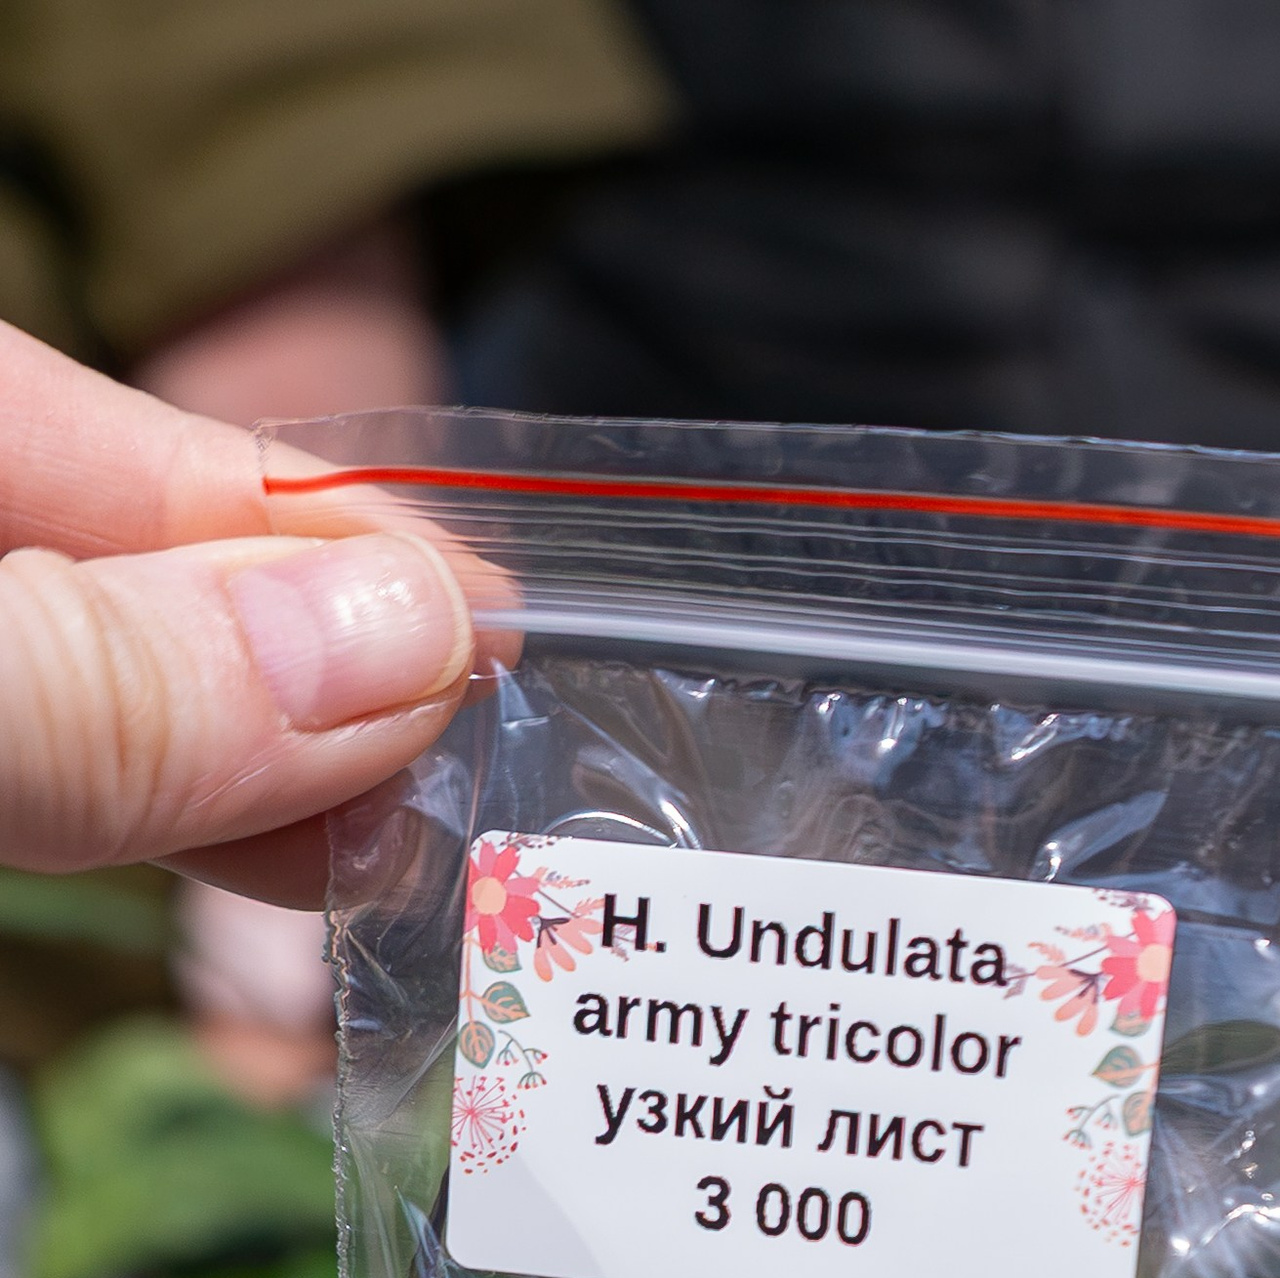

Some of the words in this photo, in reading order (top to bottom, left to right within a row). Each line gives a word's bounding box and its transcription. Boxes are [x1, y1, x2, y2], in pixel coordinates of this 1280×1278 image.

[600, 893, 667, 954] H.
[696, 902, 1008, 989] Undulata
[572, 991, 749, 1066] army
[770, 1002, 1022, 1079] tricolor
[593, 1080, 794, 1150] узкий
[816, 1107, 986, 1168] лист
[694, 1174, 732, 1232] 3
[754, 1185, 873, 1247] 000
